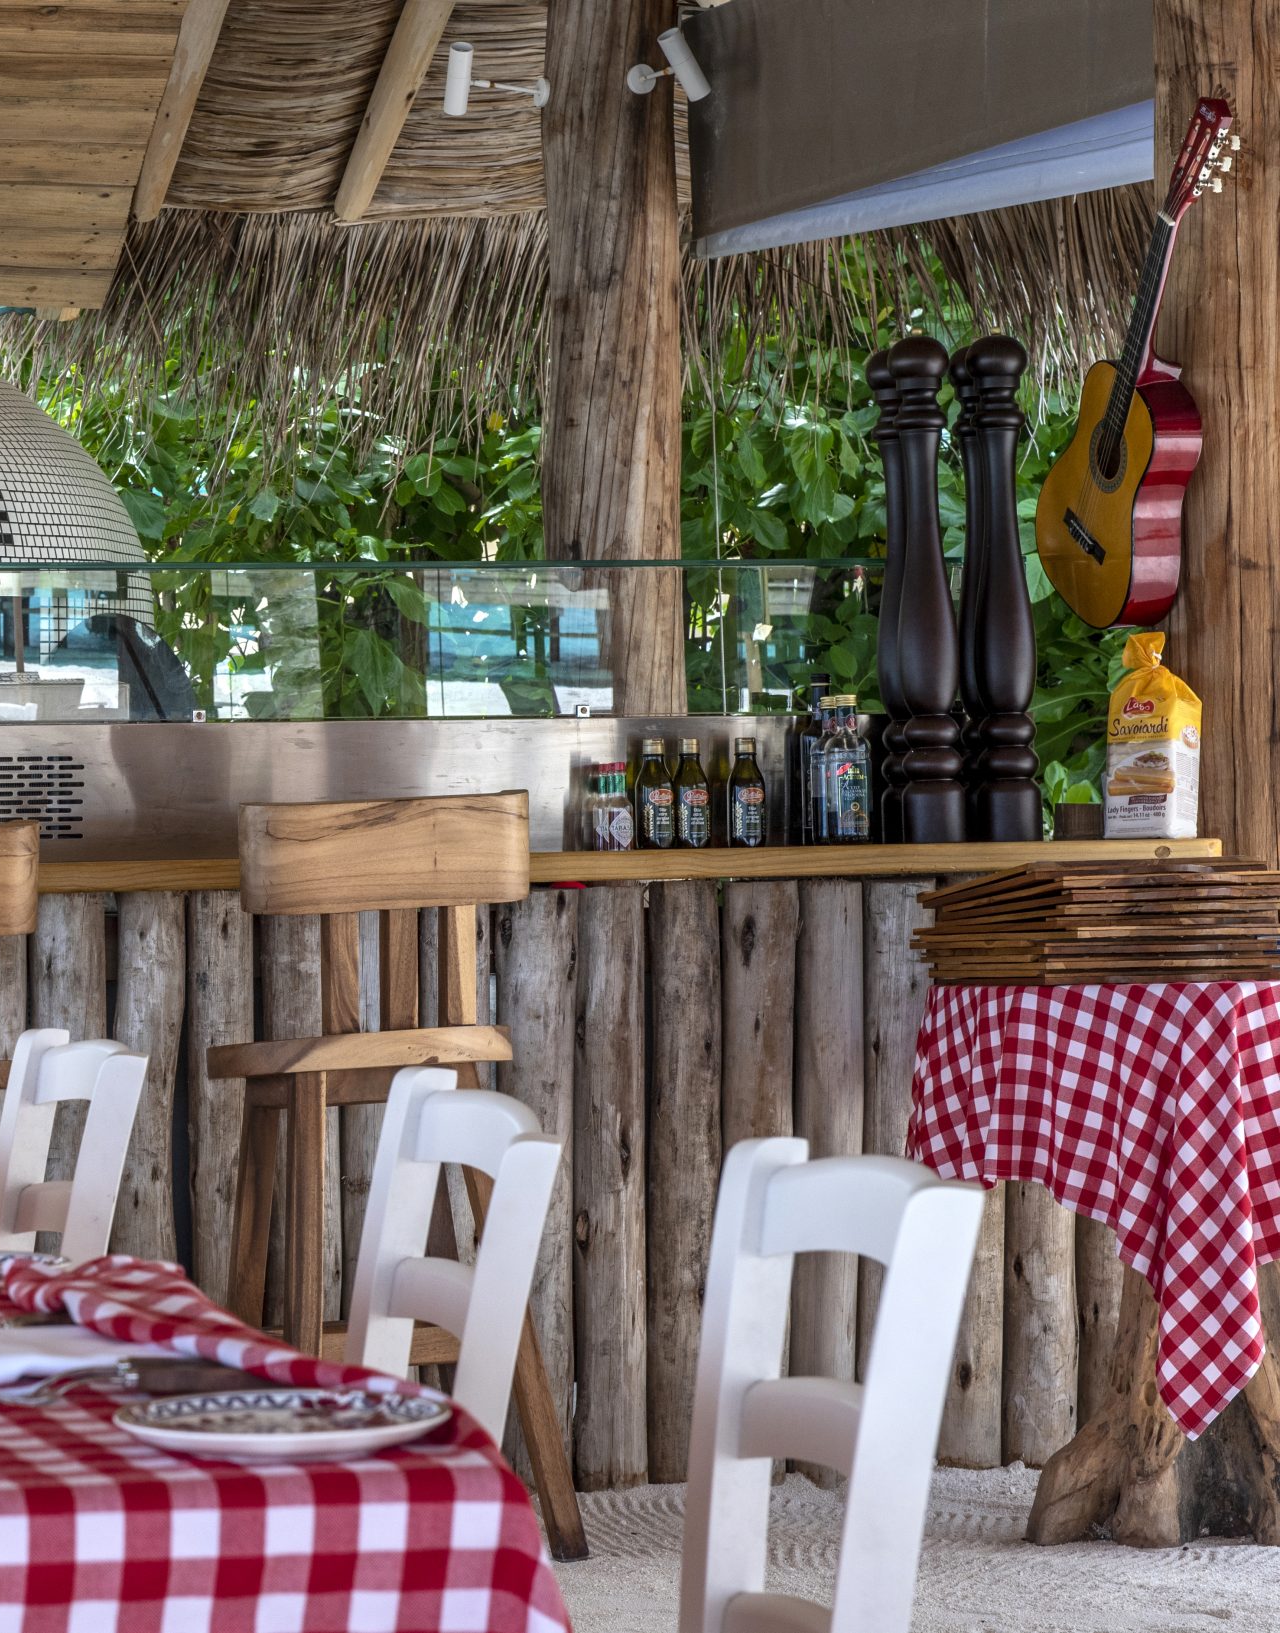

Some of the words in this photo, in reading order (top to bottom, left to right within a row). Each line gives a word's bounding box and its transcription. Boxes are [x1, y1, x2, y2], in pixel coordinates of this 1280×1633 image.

[1109, 716, 1168, 737] Savoiardi
[1108, 806, 1119, 814] Lady
[1120, 805, 1139, 814] Fingers
